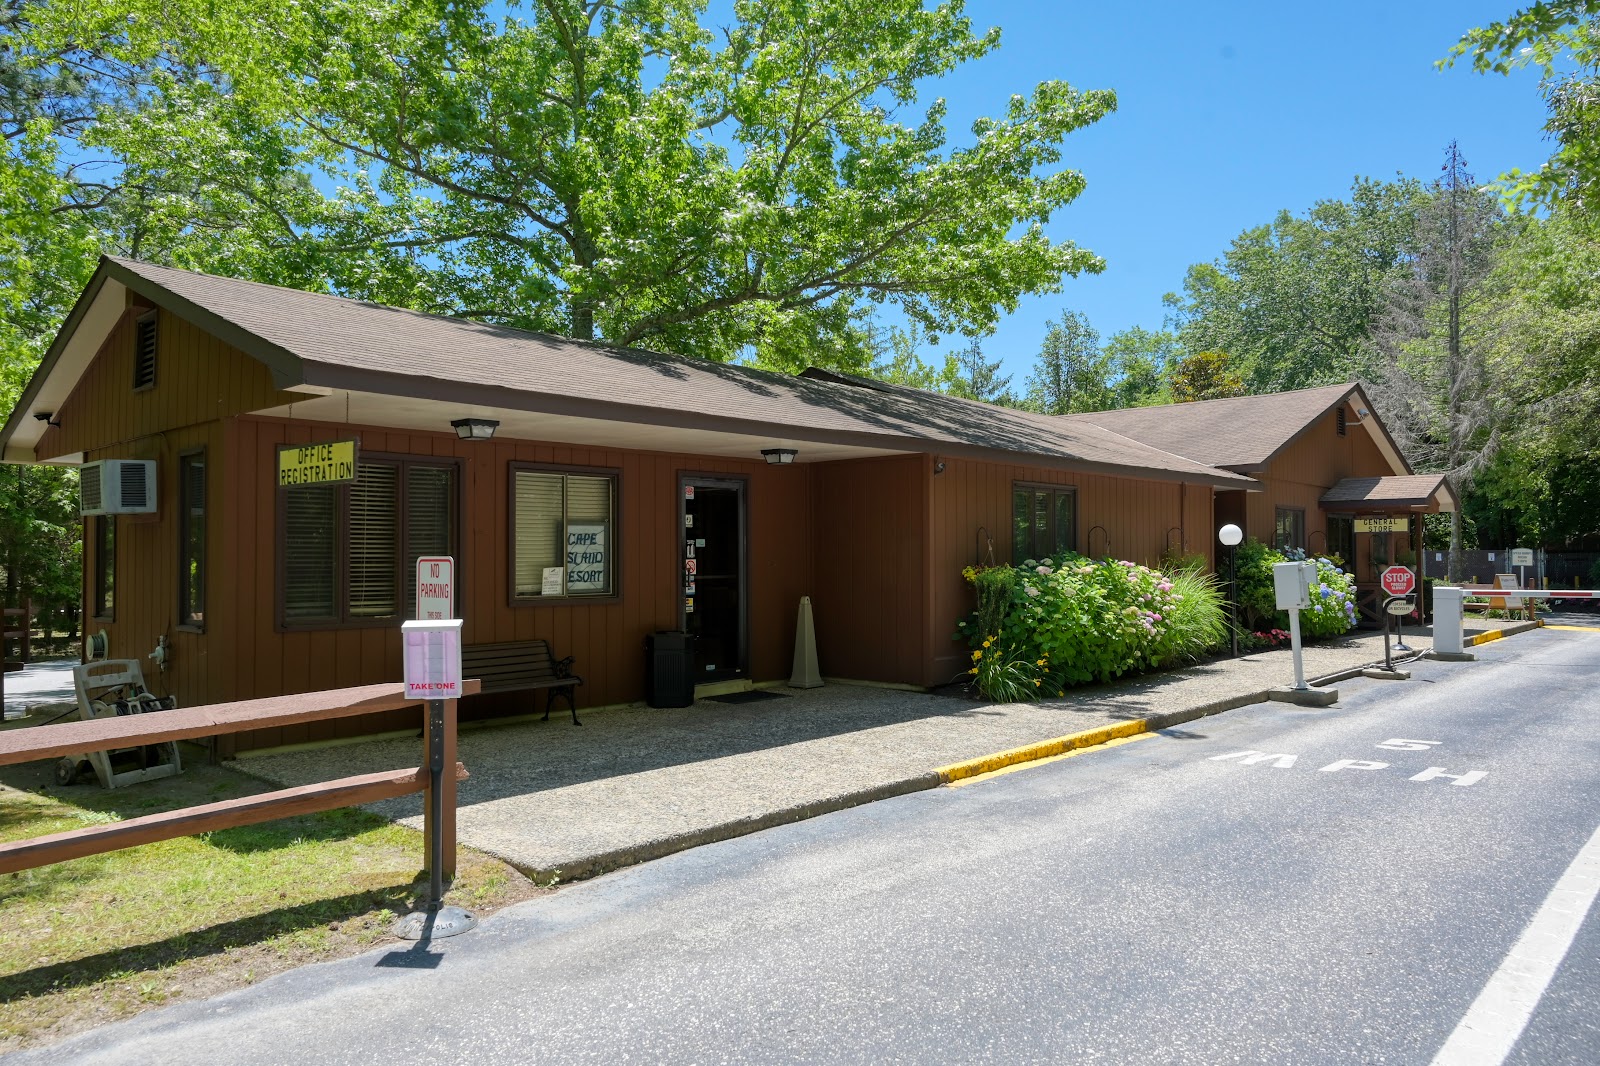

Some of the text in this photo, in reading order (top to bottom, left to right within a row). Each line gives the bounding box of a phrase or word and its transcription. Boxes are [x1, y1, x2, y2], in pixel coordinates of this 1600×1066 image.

[298, 444, 333, 464] OFFICE
[281, 461, 352, 485] REGISTRATION
[1363, 518, 1398, 526] GENERAL
[1368, 525, 1393, 533] STORE
[567, 533, 597, 546] CAPE
[567, 551, 603, 566] SLAND
[430, 563, 440, 578] NO
[567, 570, 602, 582] ESORT
[1385, 573, 1411, 583] STOP
[420, 583, 449, 599] PARKING
[436, 682, 455, 690] ONE
